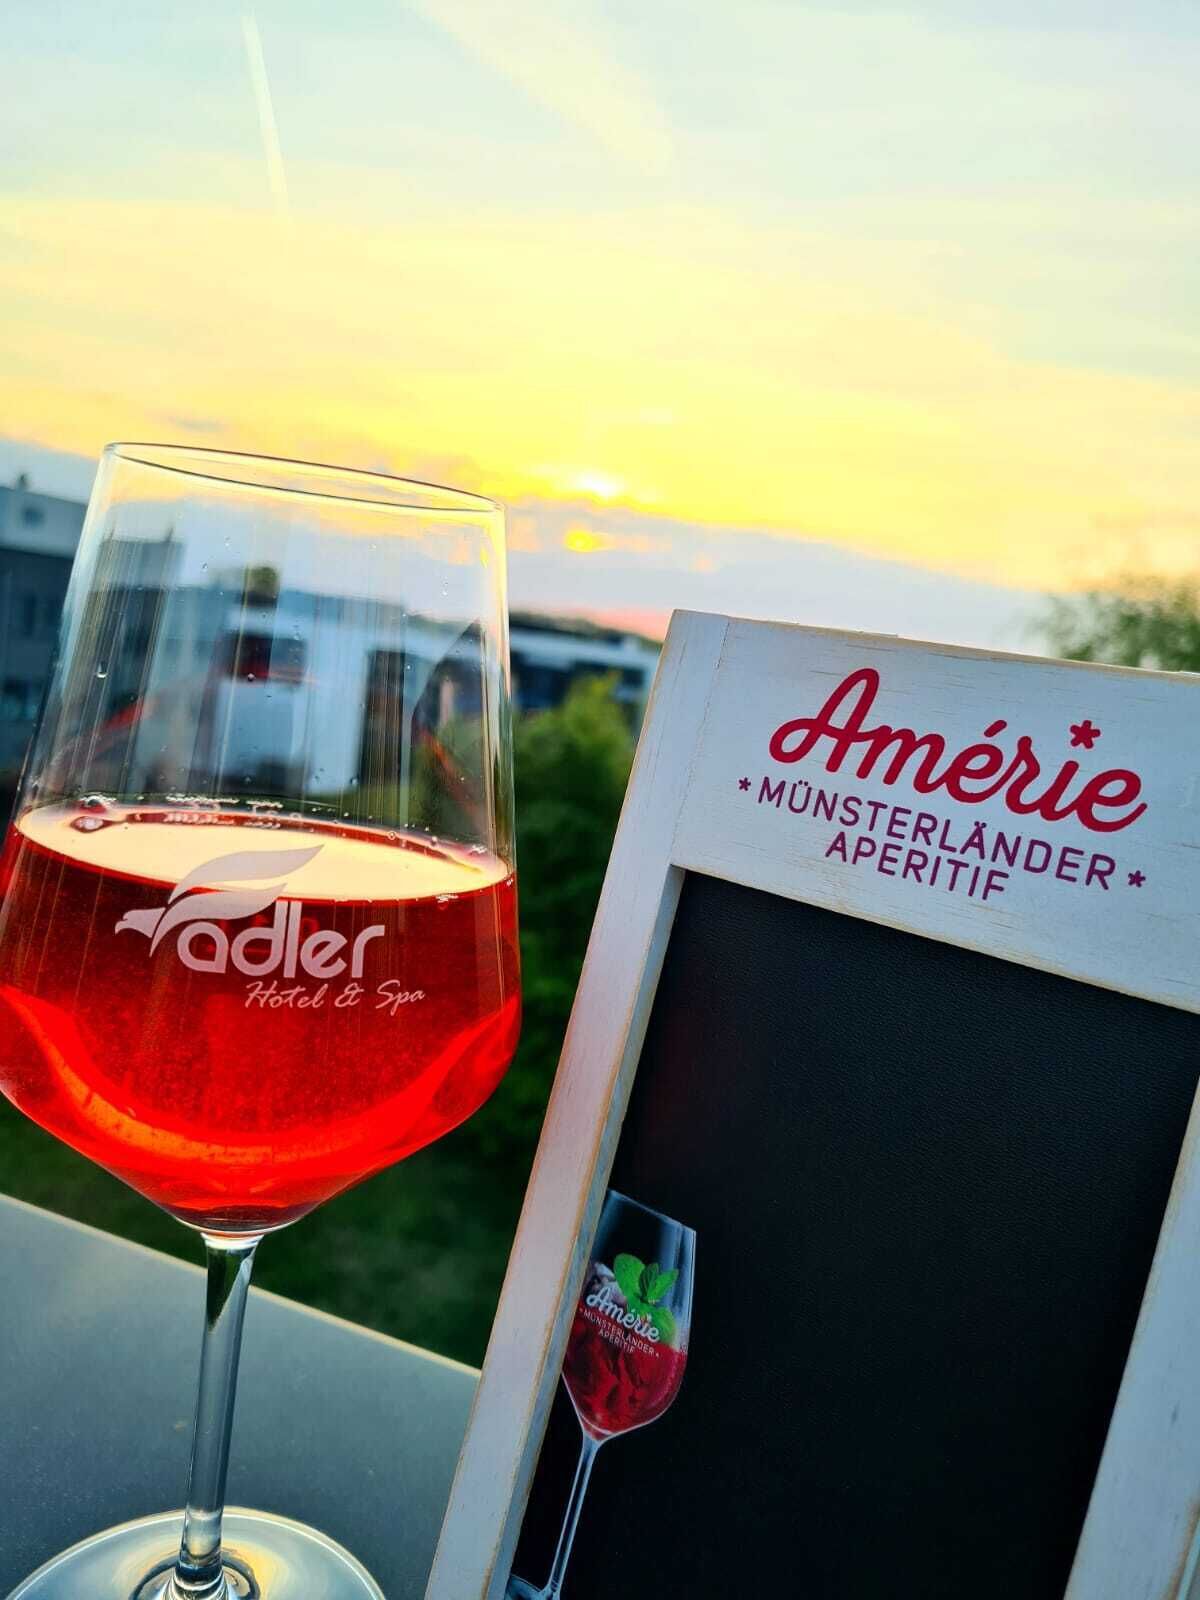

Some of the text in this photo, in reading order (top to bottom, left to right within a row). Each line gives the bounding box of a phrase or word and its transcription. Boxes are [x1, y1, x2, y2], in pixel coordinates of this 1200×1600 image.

[769, 667, 1147, 832] Amérie
[757, 775, 1115, 890] MÜNSTERLÄNDER
[825, 831, 1010, 901] APERITIF
[177, 900, 385, 978] adler
[245, 979, 426, 1016] Hotel & Spa
[586, 1285, 660, 1343] Amérie
[599, 1328, 635, 1354] APERITIF
